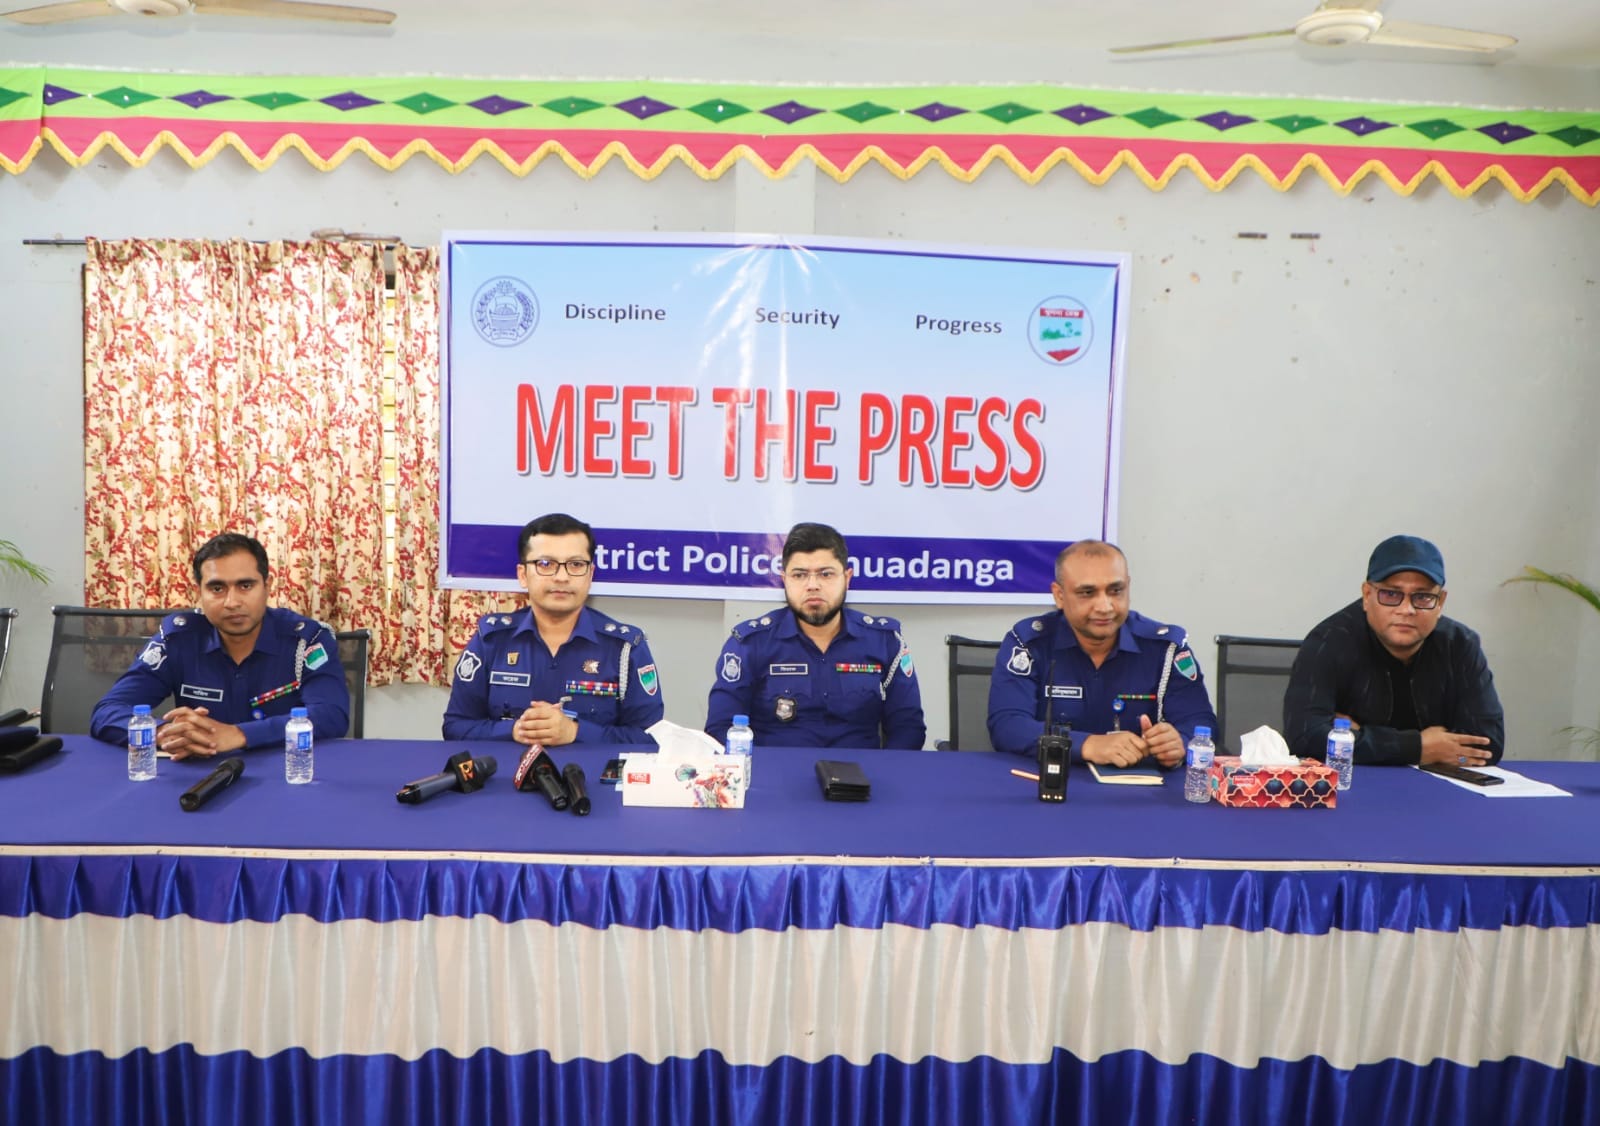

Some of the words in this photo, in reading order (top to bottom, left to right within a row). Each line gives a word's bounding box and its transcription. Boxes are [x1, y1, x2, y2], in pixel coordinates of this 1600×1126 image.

[565, 303, 667, 324] Discipline
[755, 307, 841, 330] Security
[915, 314, 1003, 336] Progress
[515, 383, 697, 479] MEET
[711, 386, 838, 483] THE
[858, 392, 1047, 491] PRESS
[594, 542, 671, 572] trict
[682, 544, 783, 576] Police
